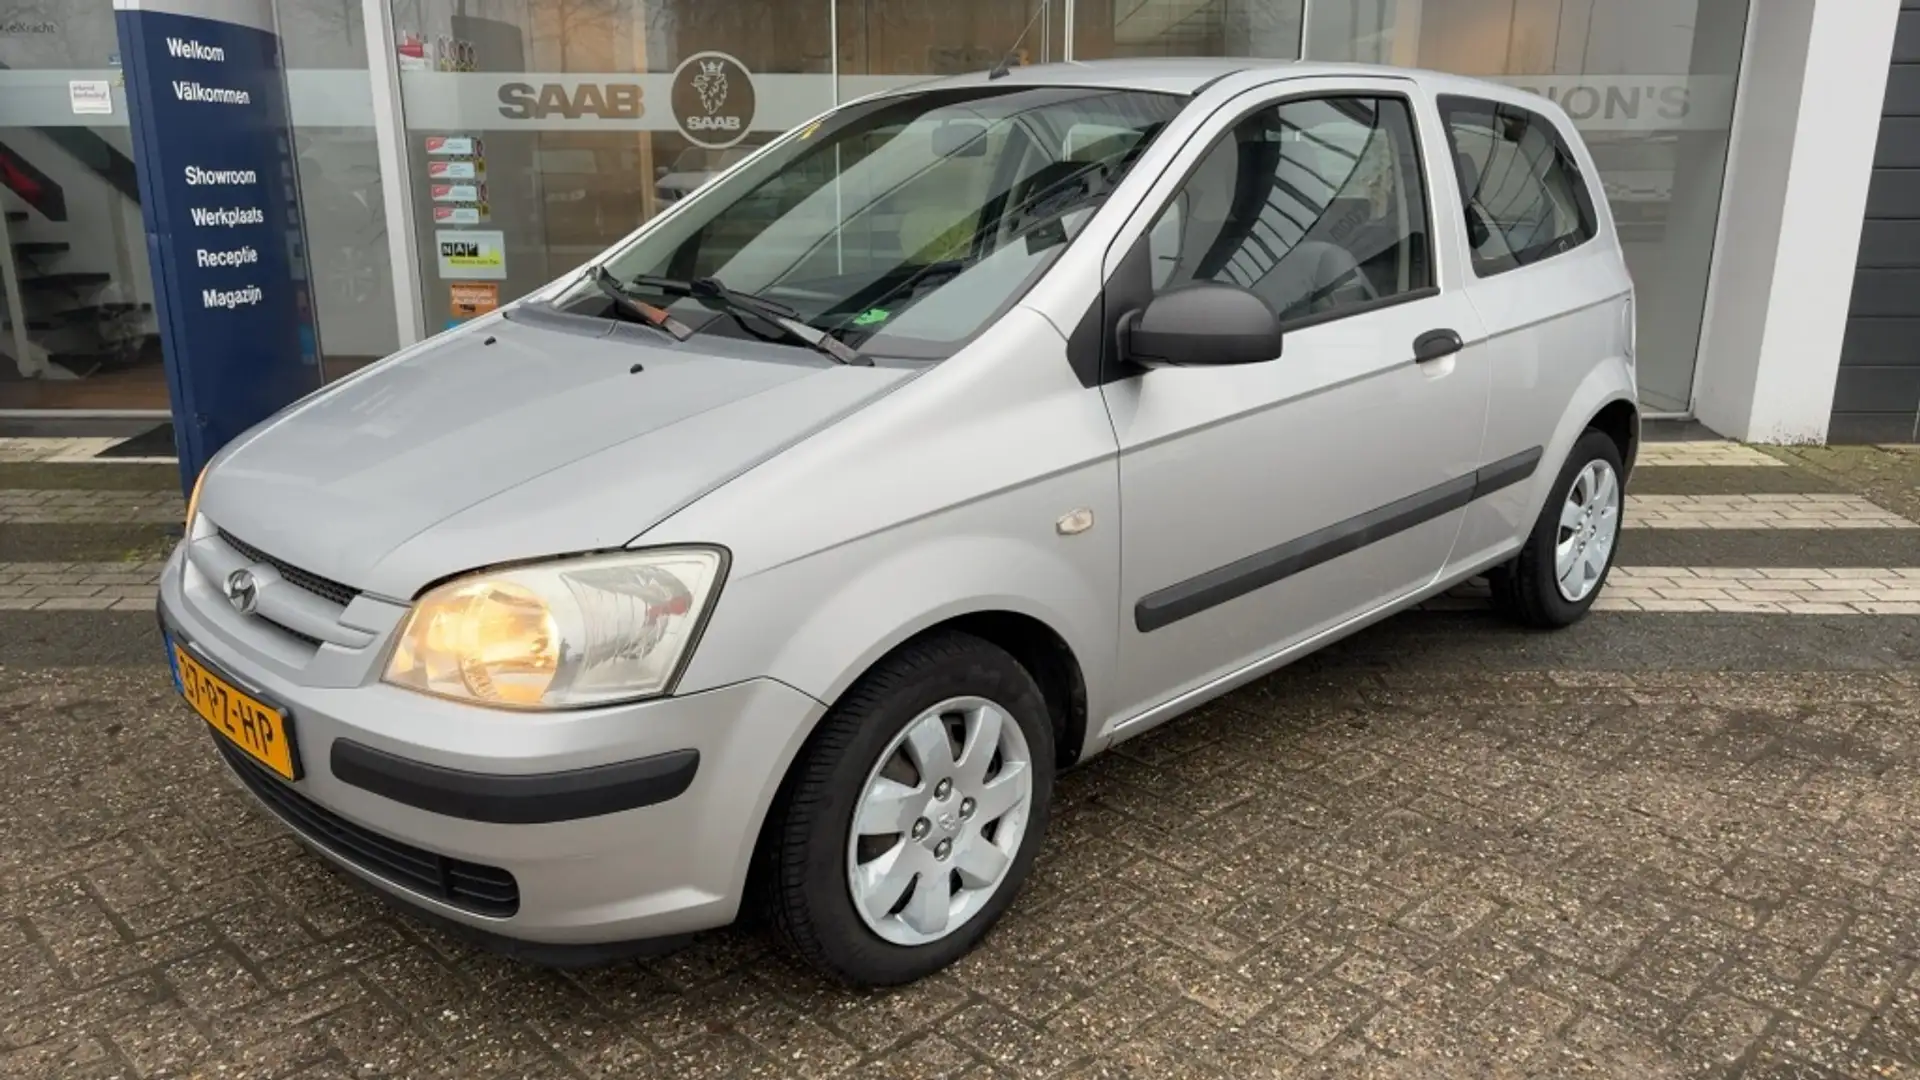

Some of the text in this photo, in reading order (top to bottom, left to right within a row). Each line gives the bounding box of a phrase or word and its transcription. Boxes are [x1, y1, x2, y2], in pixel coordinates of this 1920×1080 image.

[166, 37, 225, 62] Welkom
[172, 80, 251, 104] Välkommen
[498, 82, 645, 119] SAAB
[686, 116, 740, 130] SAAB
[184, 165, 257, 185] Showroom
[191, 207, 264, 228] Werkplaats
[197, 246, 258, 268] Receptie
[441, 242, 478, 256] NAP
[202, 285, 263, 309] Magazijn
